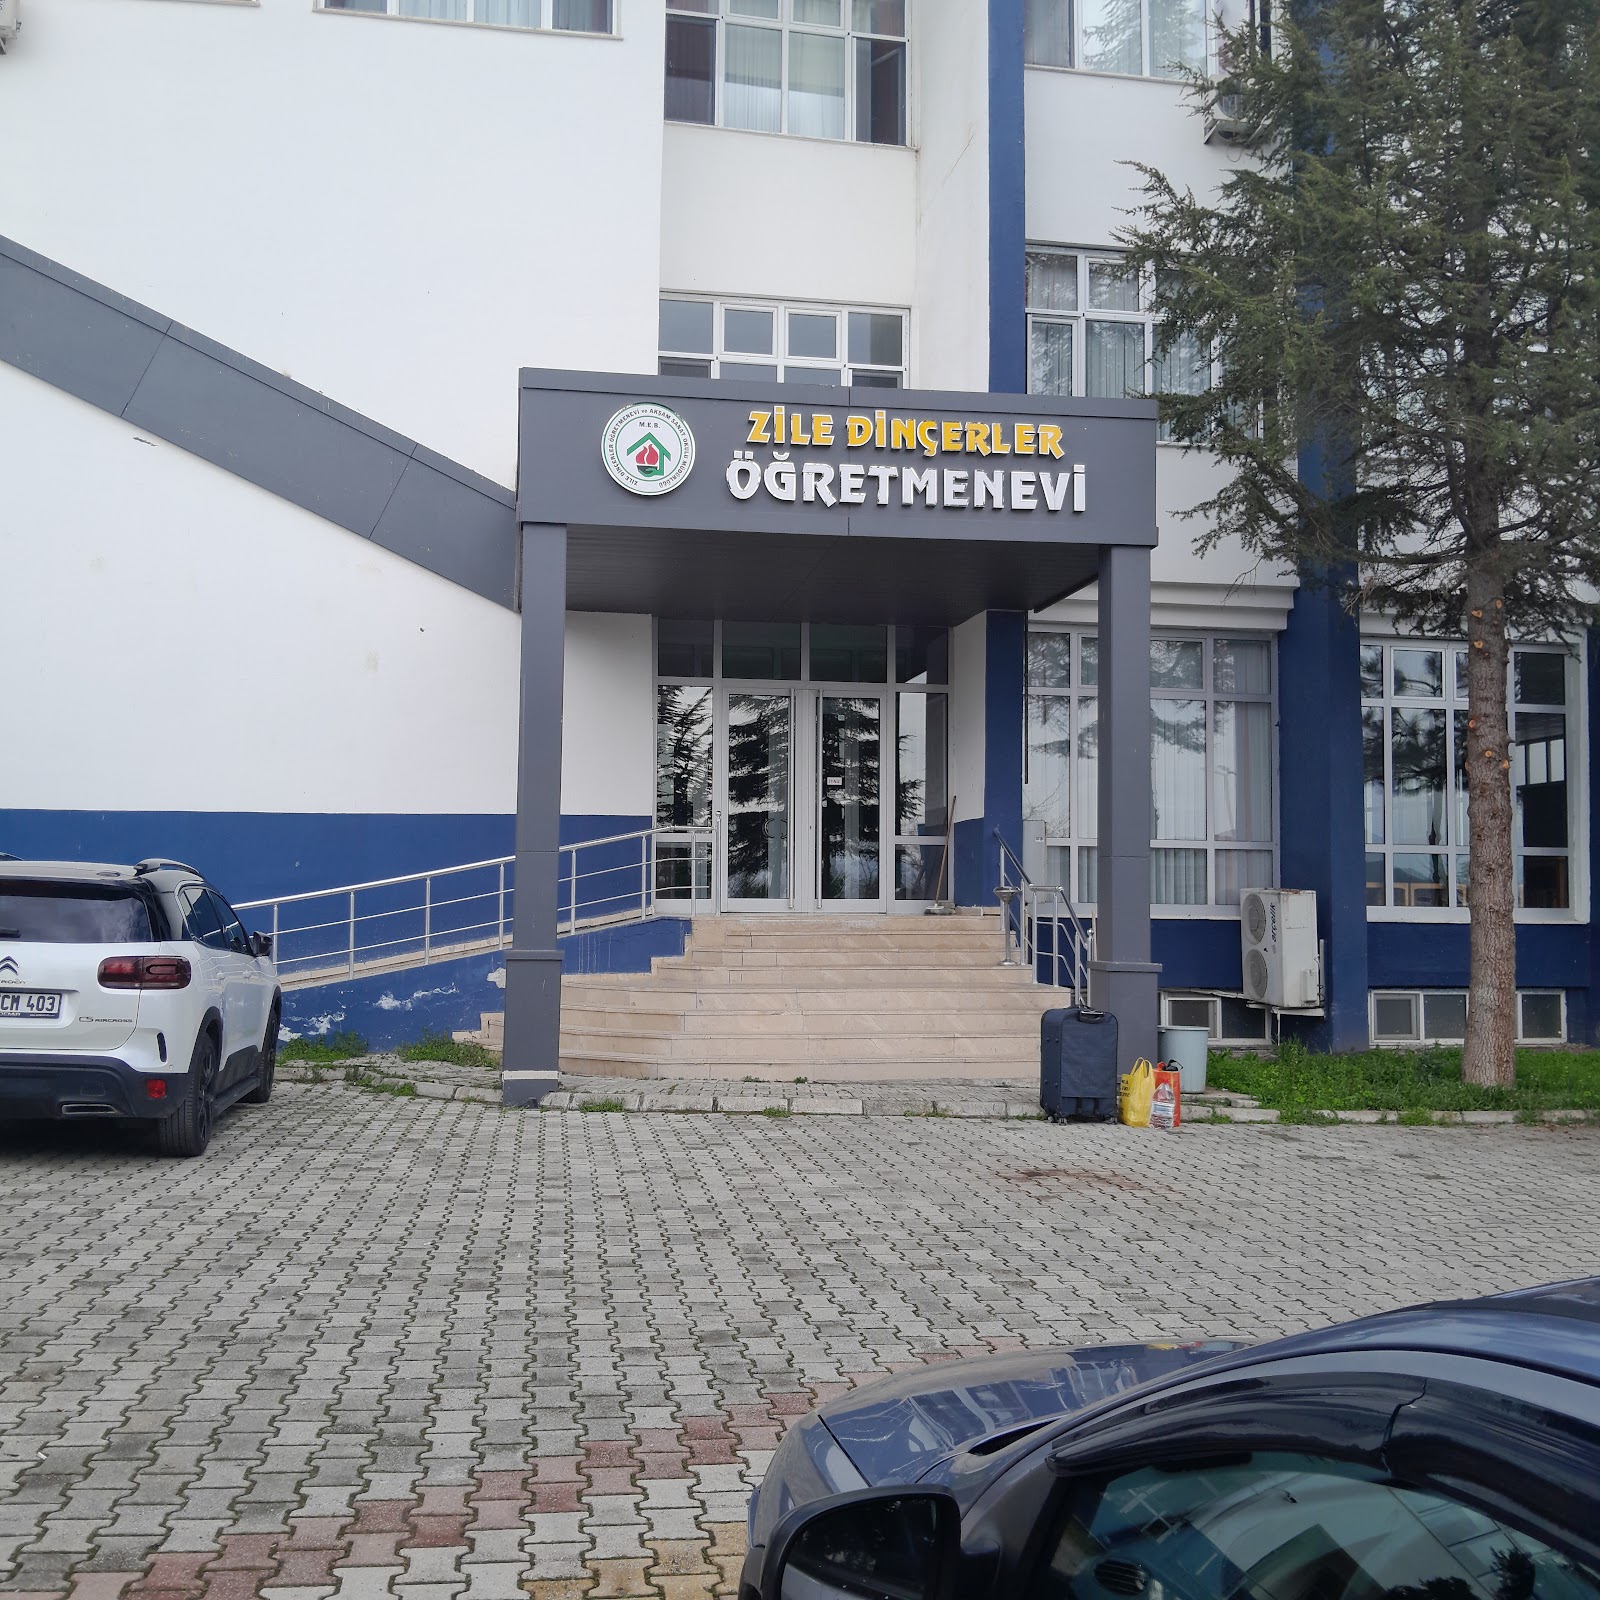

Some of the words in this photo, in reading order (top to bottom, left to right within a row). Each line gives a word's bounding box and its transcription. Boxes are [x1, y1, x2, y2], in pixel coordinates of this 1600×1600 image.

[608, 408, 640, 443] ÖĞRETMENEVİ
[649, 408, 672, 420] AKŞAM
[671, 418, 686, 436] SANAT
[638, 421, 661, 429] M.E.B.
[746, 405, 836, 446] ZİLE
[846, 409, 1066, 459] DİNÇERLER
[726, 450, 1086, 512] ÖĞRETMENEVİ
[26, 995, 56, 1012] 403
